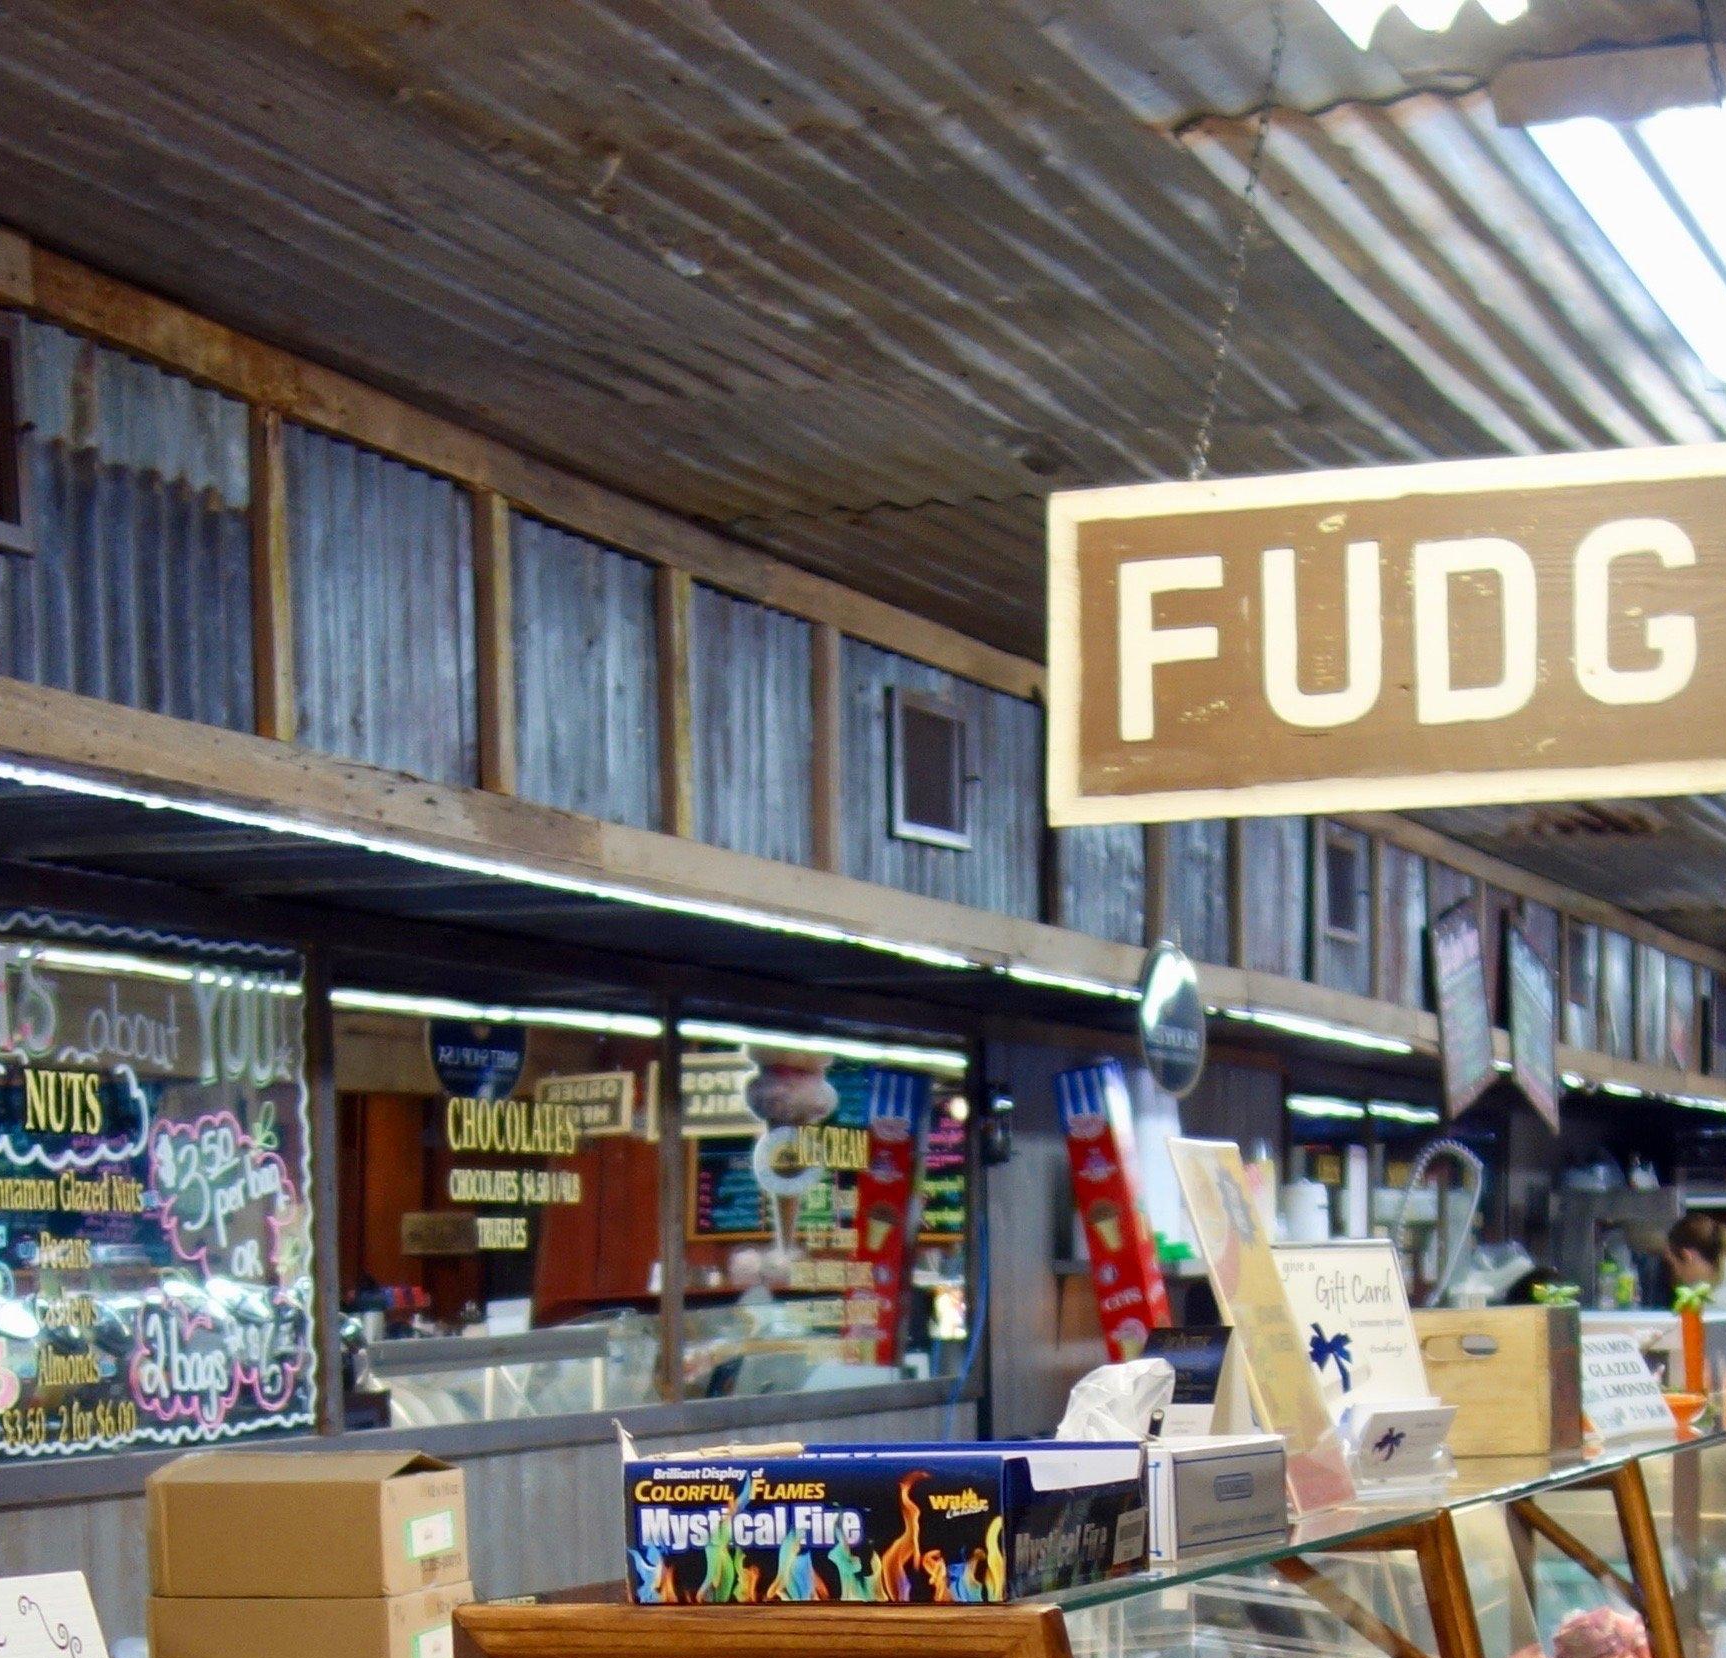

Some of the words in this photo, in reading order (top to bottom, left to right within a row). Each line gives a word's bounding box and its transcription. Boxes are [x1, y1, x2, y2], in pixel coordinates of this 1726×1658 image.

[24, 1068, 103, 1136] NUTS
[447, 1097, 577, 1155] CHOCOLATES
[823, 1126, 869, 1169] CREAM
[59, 1170, 110, 1213] Glazed
[112, 1174, 146, 1214] Nuts
[449, 1168, 520, 1203] CHOCOLATES
[38, 1231, 92, 1271] Pecans
[476, 1216, 528, 1250] TRUFFLES
[1315, 1270, 1347, 1314] Gift
[1351, 1268, 1393, 1305] Card
[36, 1347, 101, 1388] Almonds
[170, 1312, 230, 1422] bags
[1588, 1361, 1642, 1378] GLAZED
[58, 1406, 70, 1444] 2
[634, 1479, 735, 1503] COLORFUL
[748, 1478, 827, 1502] FLAMES
[652, 1466, 702, 1482] Brilliant
[702, 1466, 748, 1483] Display
[751, 1466, 765, 1478] of
[639, 1504, 792, 1550] Mystical
[796, 1506, 862, 1549] Fire
